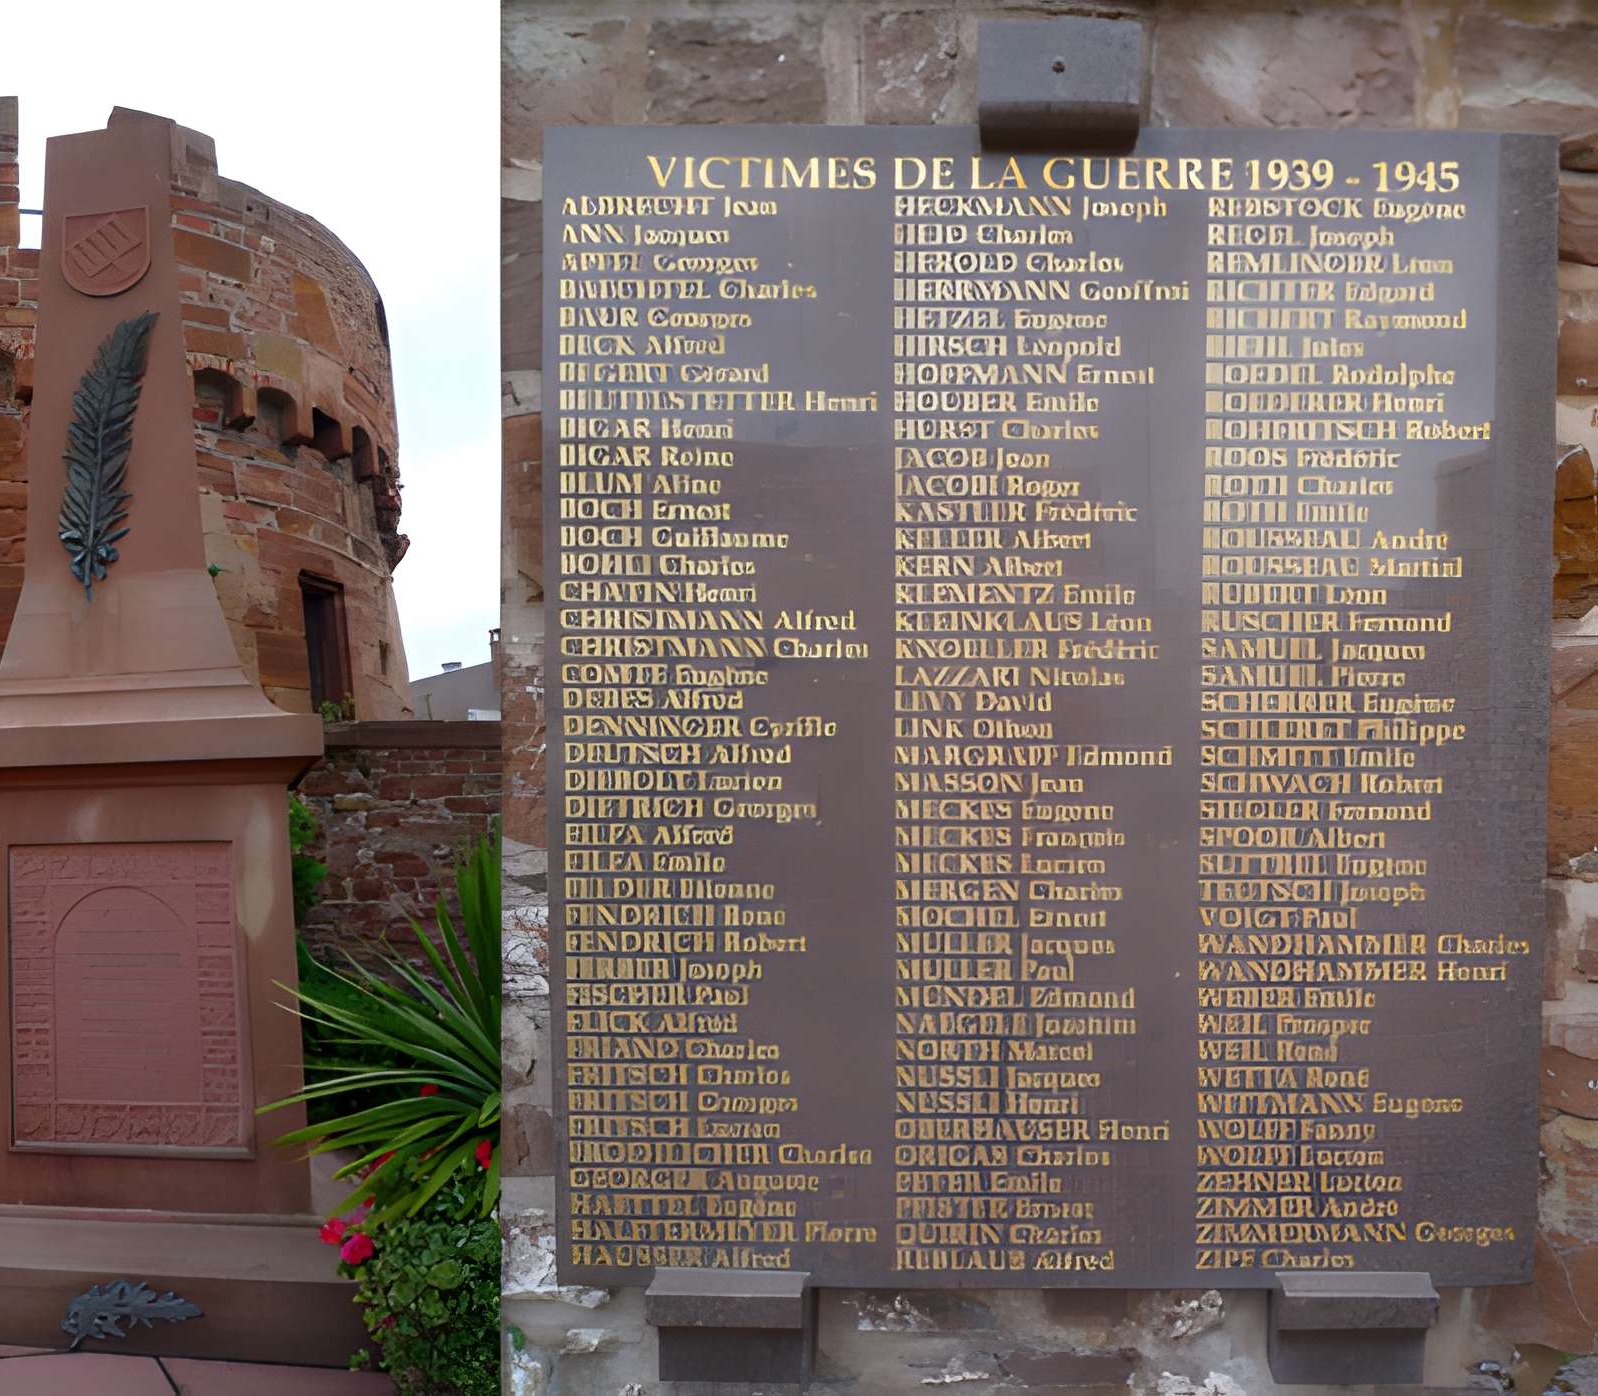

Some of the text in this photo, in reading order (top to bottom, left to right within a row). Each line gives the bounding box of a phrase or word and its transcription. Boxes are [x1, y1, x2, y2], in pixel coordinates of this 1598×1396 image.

[647, 156, 877, 188] VICTIMES
[894, 157, 954, 189] DE
[971, 156, 1027, 189] LA
[1043, 156, 1234, 190] GUERRE
[1245, 159, 1334, 191] 1939
[1373, 161, 1460, 193] 1945
